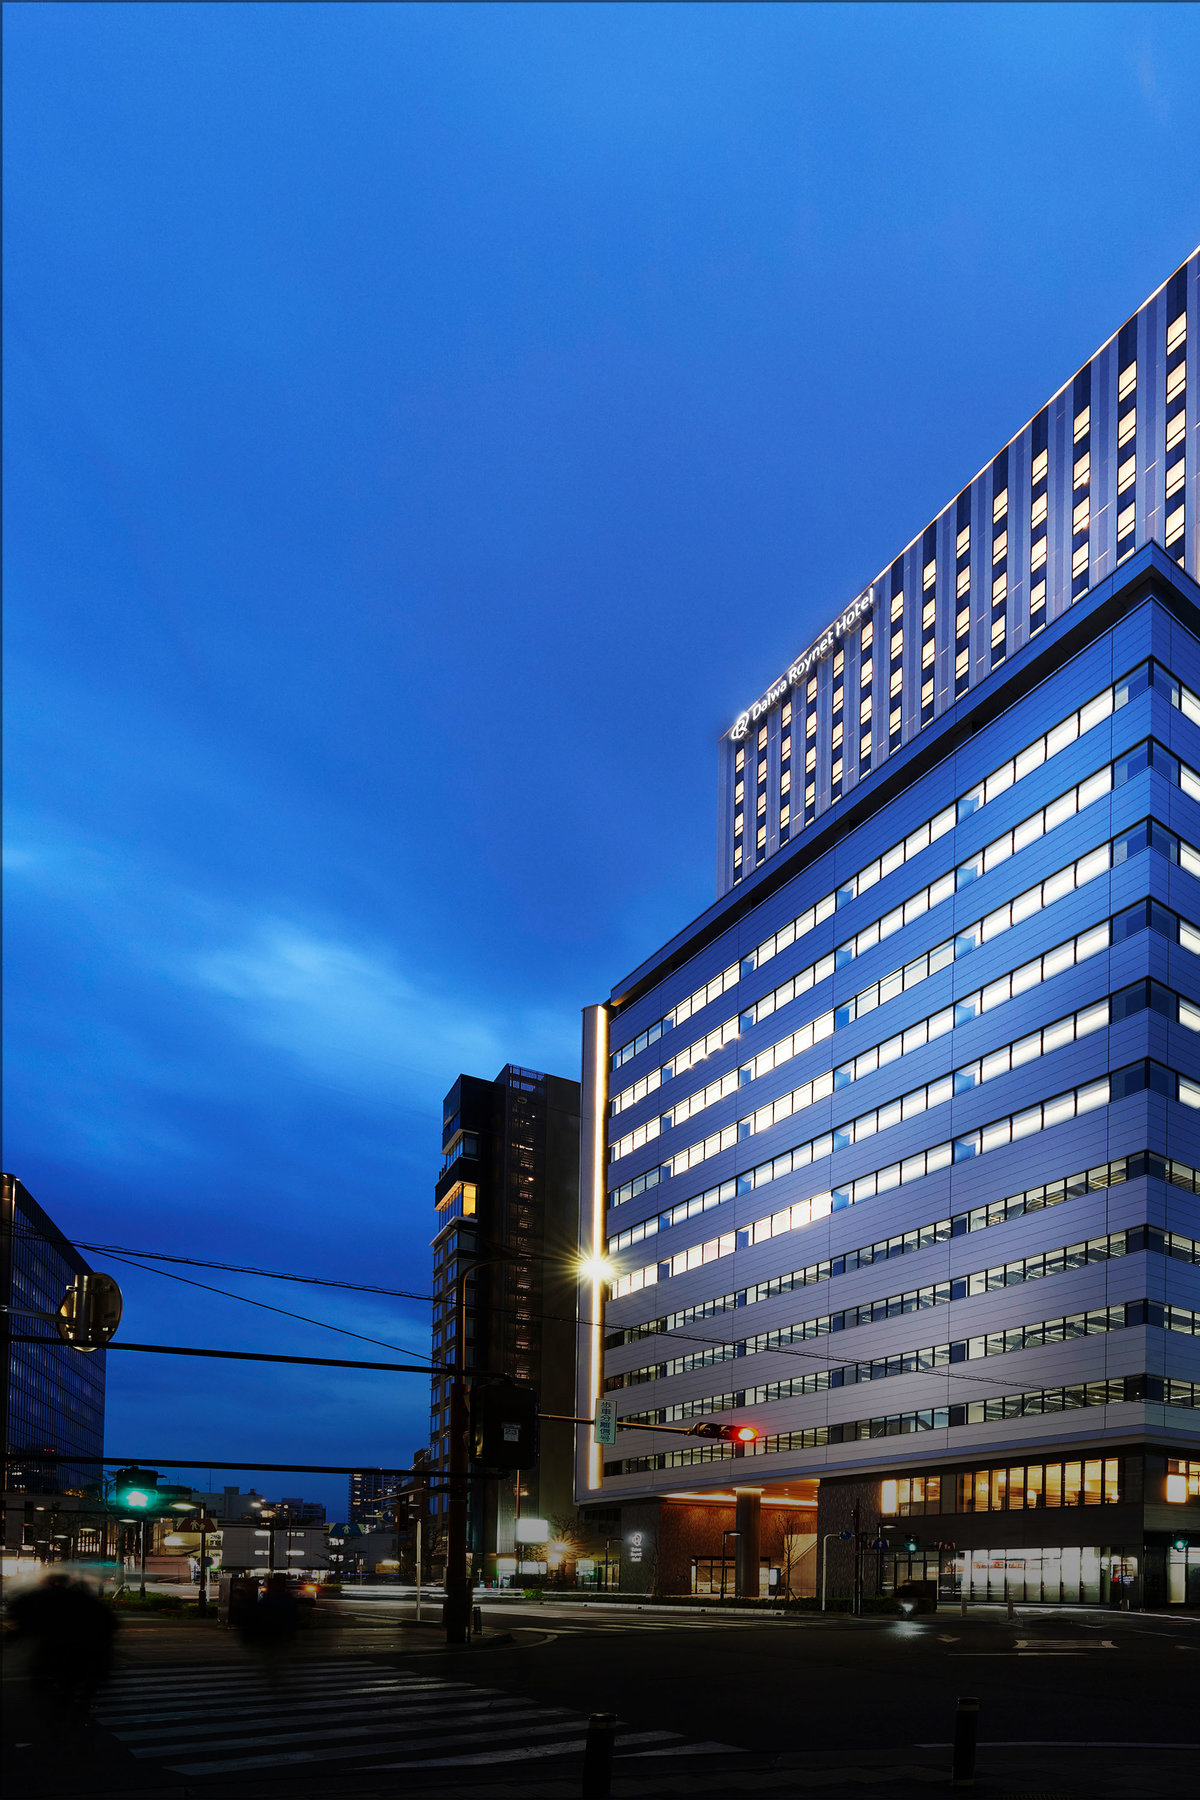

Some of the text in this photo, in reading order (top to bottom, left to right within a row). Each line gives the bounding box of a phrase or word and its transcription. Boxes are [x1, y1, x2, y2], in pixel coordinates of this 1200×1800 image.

[752, 587, 874, 720] Daiwa Roynet Hotel
